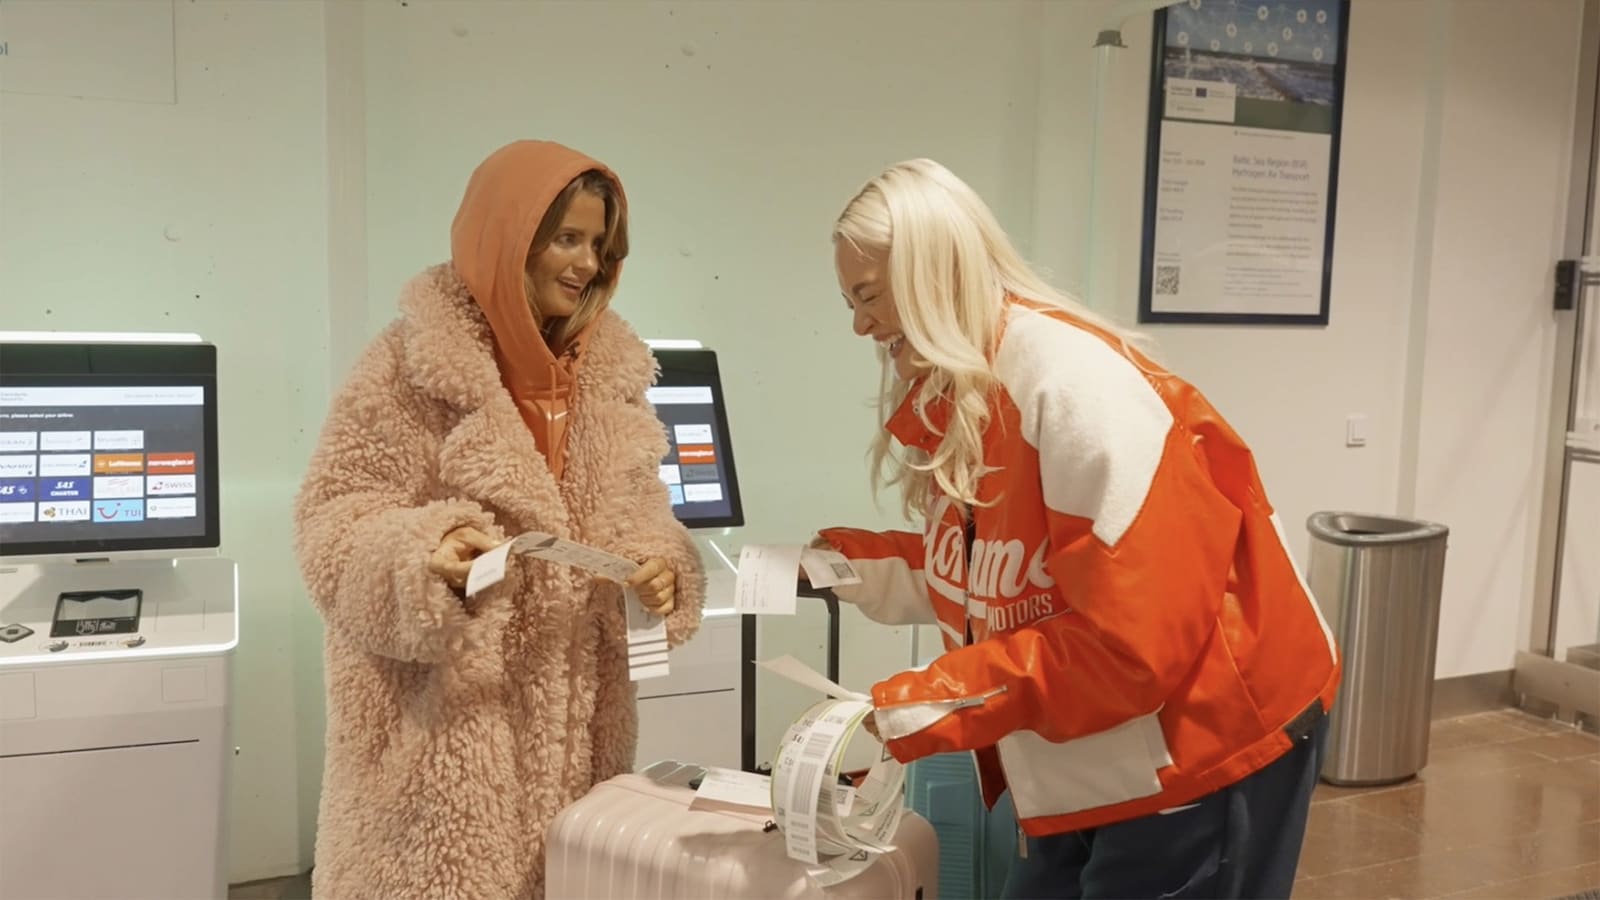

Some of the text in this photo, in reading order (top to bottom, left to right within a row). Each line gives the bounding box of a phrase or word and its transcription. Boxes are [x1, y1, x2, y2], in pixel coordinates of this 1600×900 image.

[55, 481, 74, 489] SAS
[164, 481, 193, 489] SWISS
[59, 507, 87, 516] THAI
[124, 510, 141, 518] TUI
